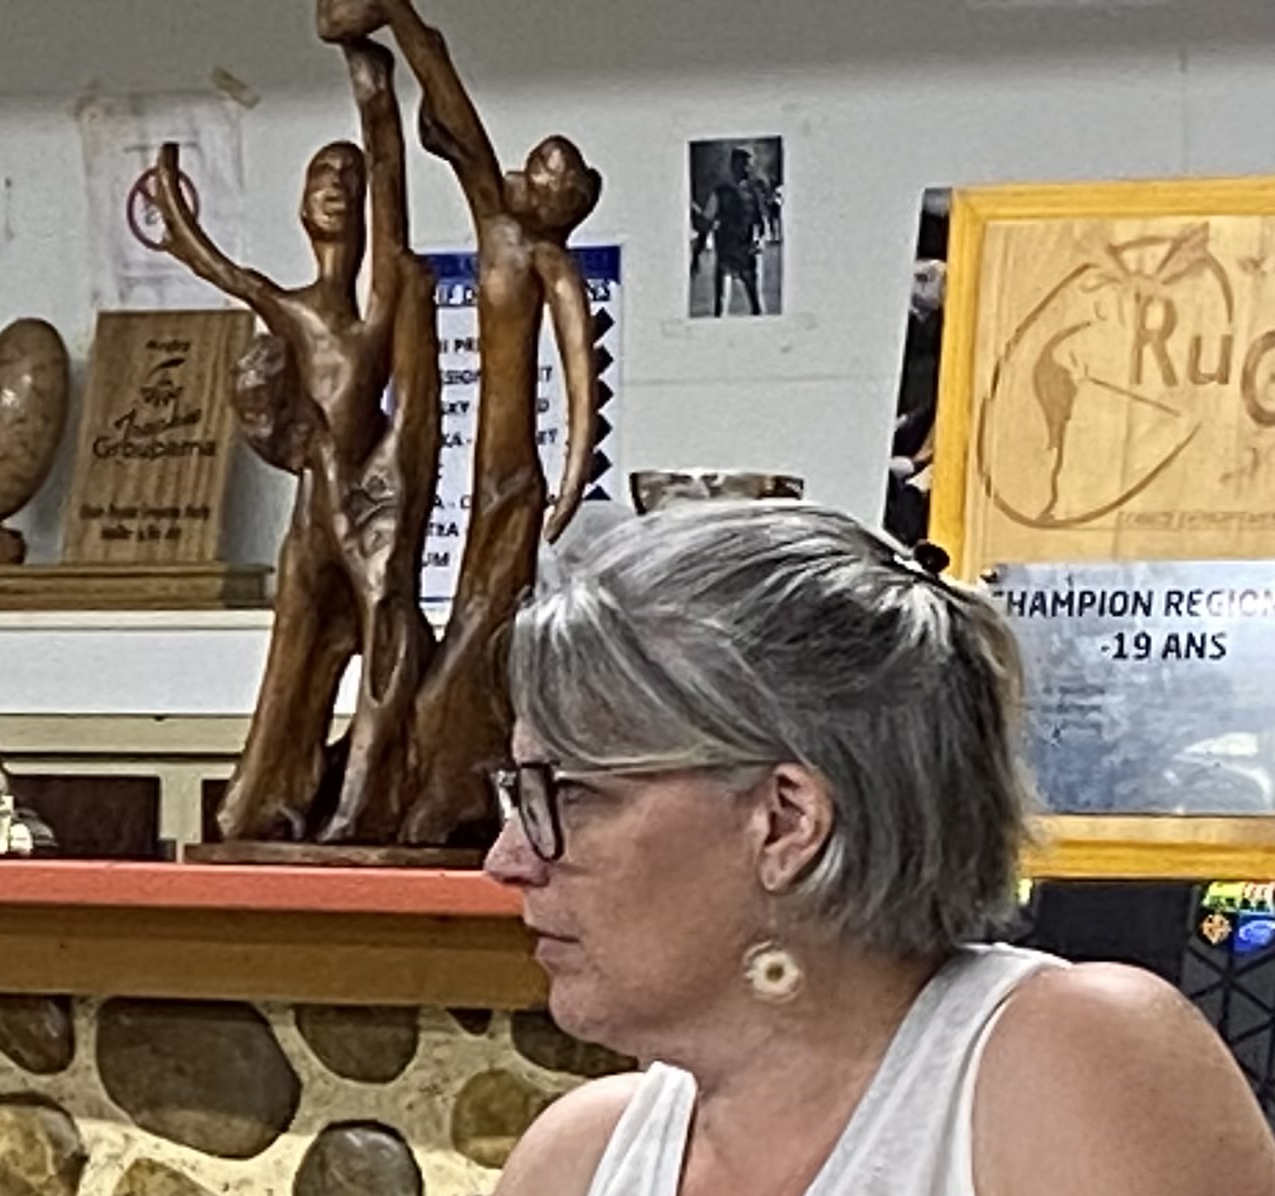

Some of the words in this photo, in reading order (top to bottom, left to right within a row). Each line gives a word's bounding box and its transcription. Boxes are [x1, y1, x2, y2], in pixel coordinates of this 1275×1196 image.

[992, 589, 1156, 618] HAMPION
[1100, 631, 1152, 660] -19
[1161, 631, 1228, 660] ANS
